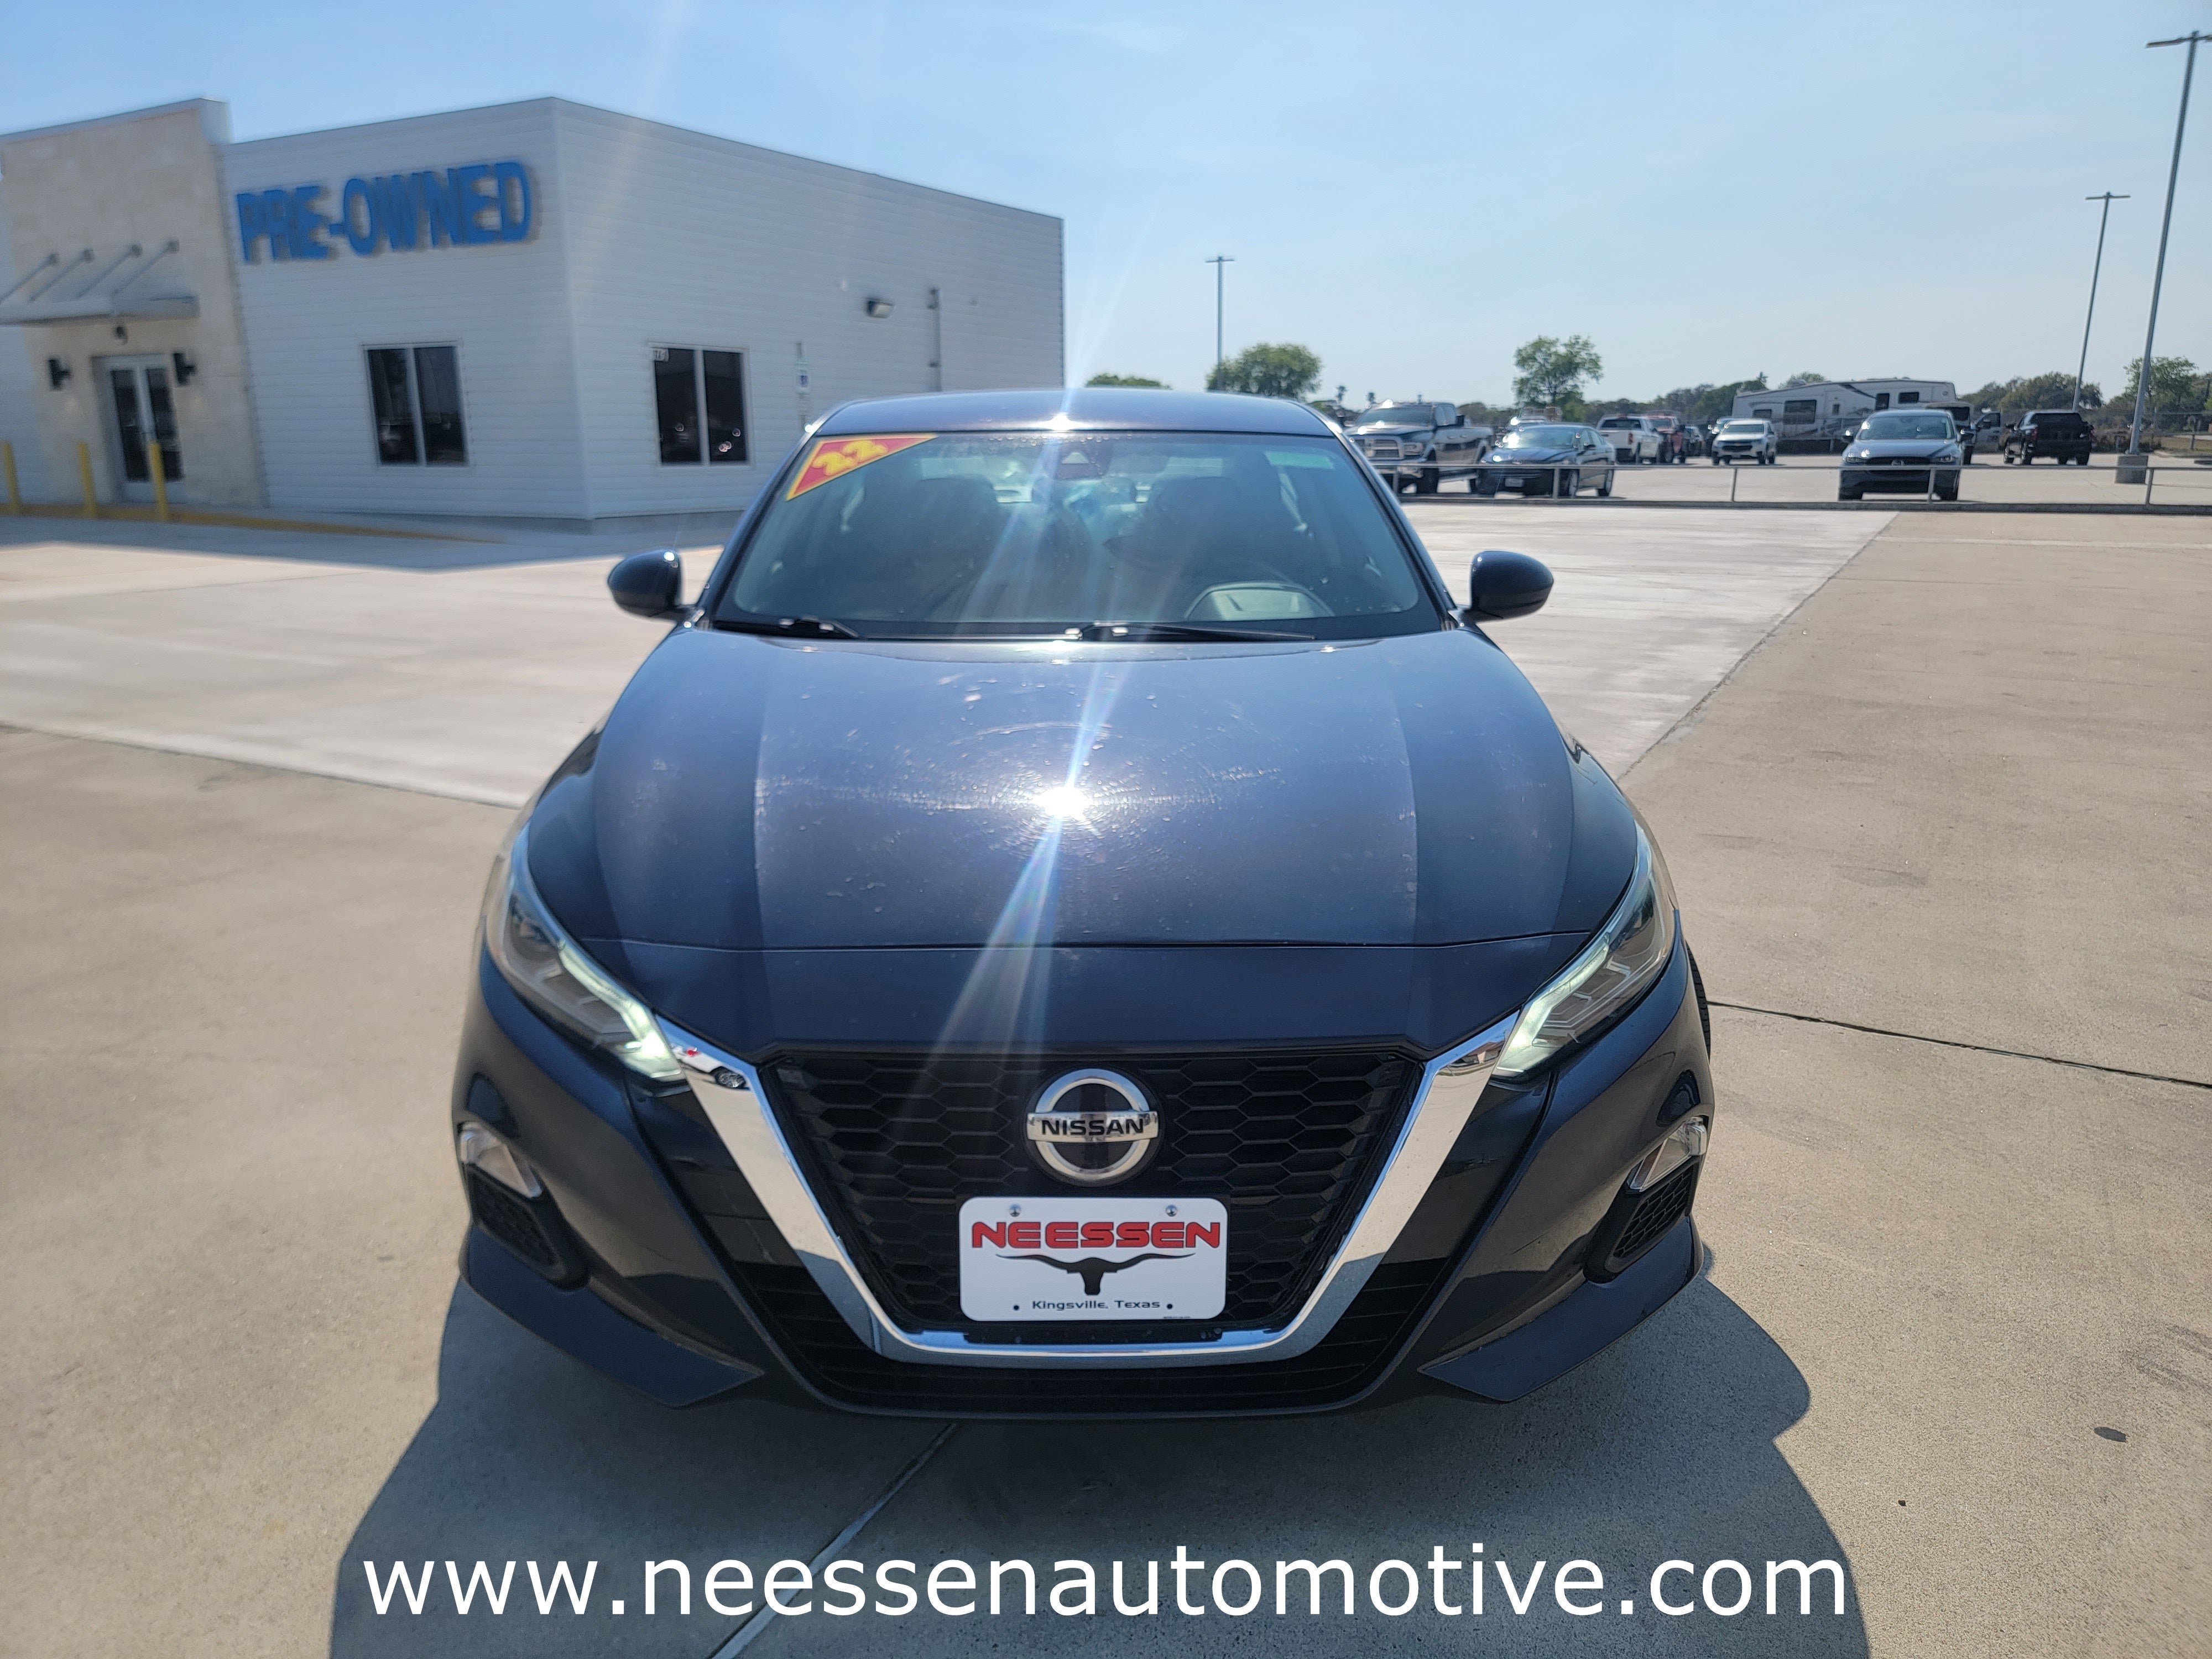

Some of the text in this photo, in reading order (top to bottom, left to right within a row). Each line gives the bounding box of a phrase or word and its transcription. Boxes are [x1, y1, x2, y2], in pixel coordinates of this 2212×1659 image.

[236, 162, 532, 263] PRE-OWNED
[812, 440, 887, 476] 22
[1042, 1119, 1144, 1135] NISSAN
[972, 1222, 1220, 1249] NEESSEN
[1114, 1300, 1161, 1309] Texas
